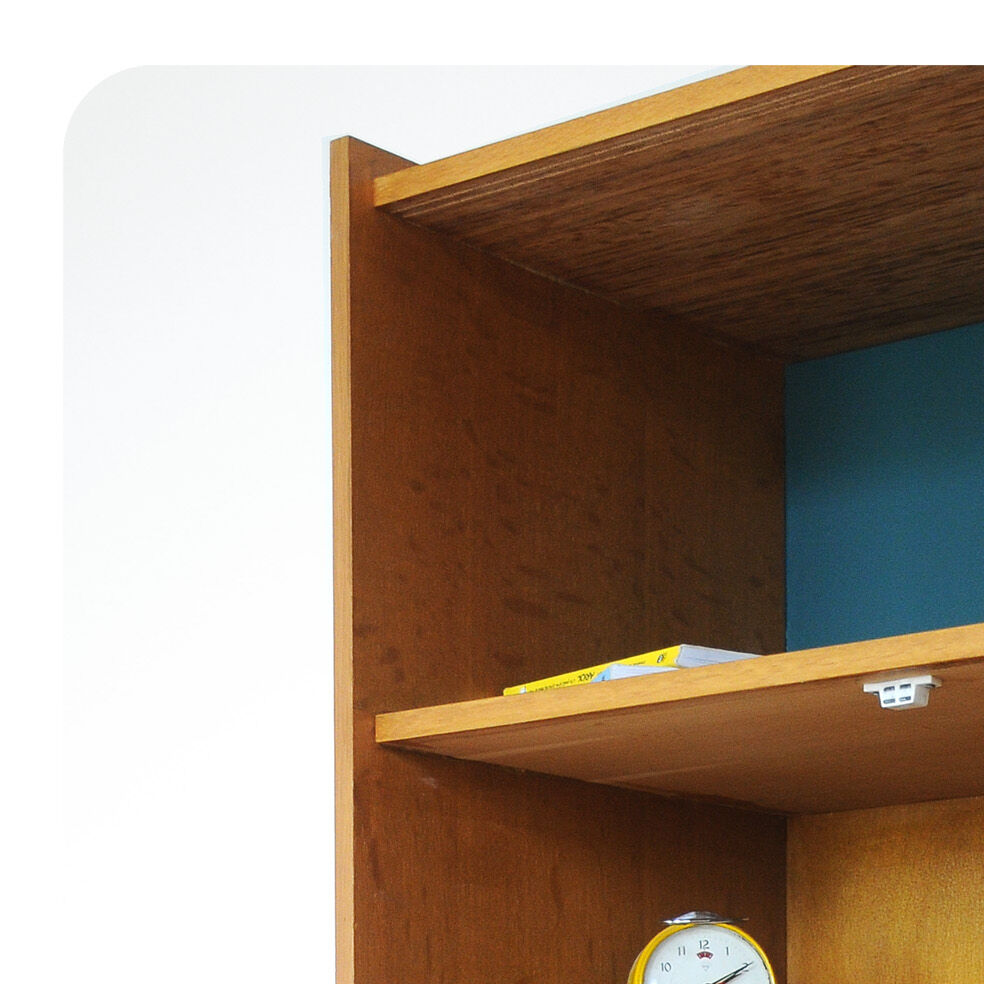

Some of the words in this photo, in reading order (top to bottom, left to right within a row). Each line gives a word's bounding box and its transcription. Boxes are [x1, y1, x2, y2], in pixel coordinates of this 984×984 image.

[699, 940, 710, 949] 12
[678, 946, 686, 956] 11
[661, 962, 672, 972] 10
